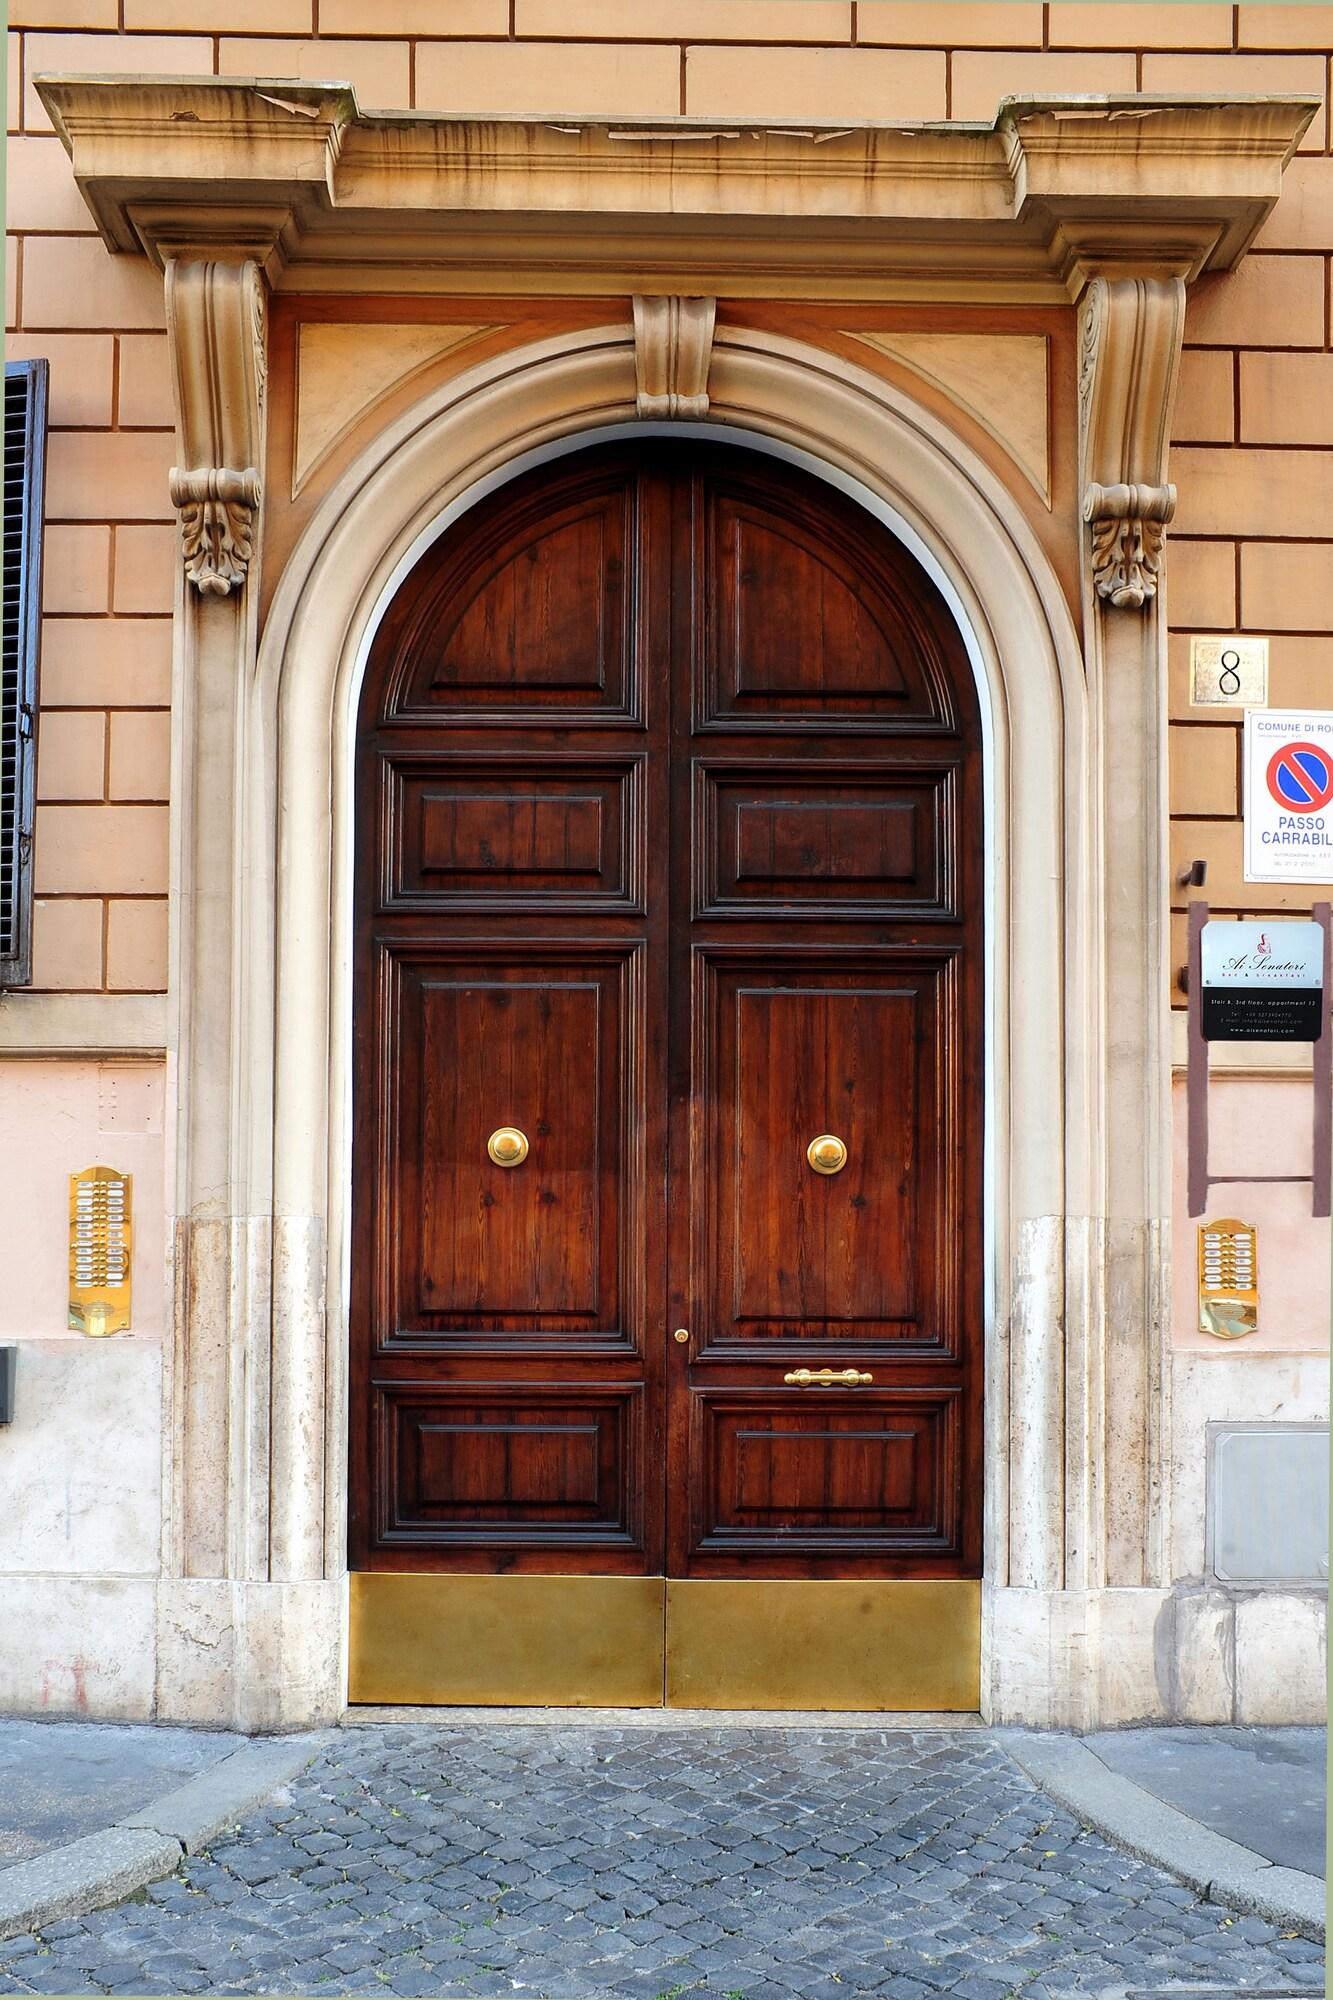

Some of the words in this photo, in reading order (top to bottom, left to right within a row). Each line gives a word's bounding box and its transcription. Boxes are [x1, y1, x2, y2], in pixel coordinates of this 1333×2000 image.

[1219, 650, 1241, 696] 8
[1257, 722, 1301, 732] COMUNE
[1304, 723, 1314, 732] DI
[1317, 724, 1333, 734] RO
[1278, 816, 1325, 830] PASSO
